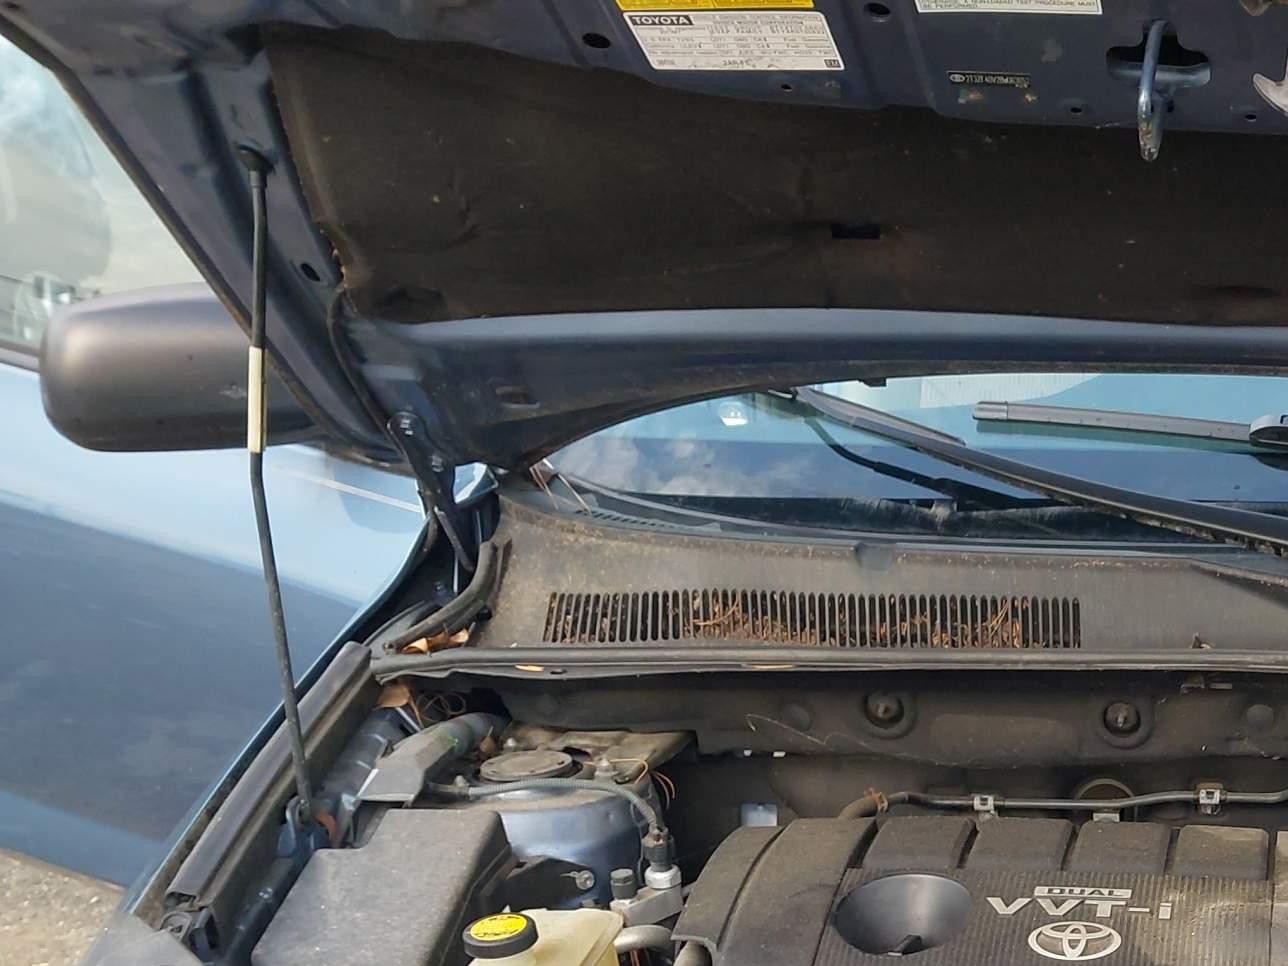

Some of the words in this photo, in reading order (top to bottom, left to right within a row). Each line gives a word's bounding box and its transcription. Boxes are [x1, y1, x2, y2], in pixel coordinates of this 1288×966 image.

[632, 16, 690, 25] TOYOTA
[1047, 888, 1124, 897] DUAL
[986, 896, 1173, 920] VVT-i
